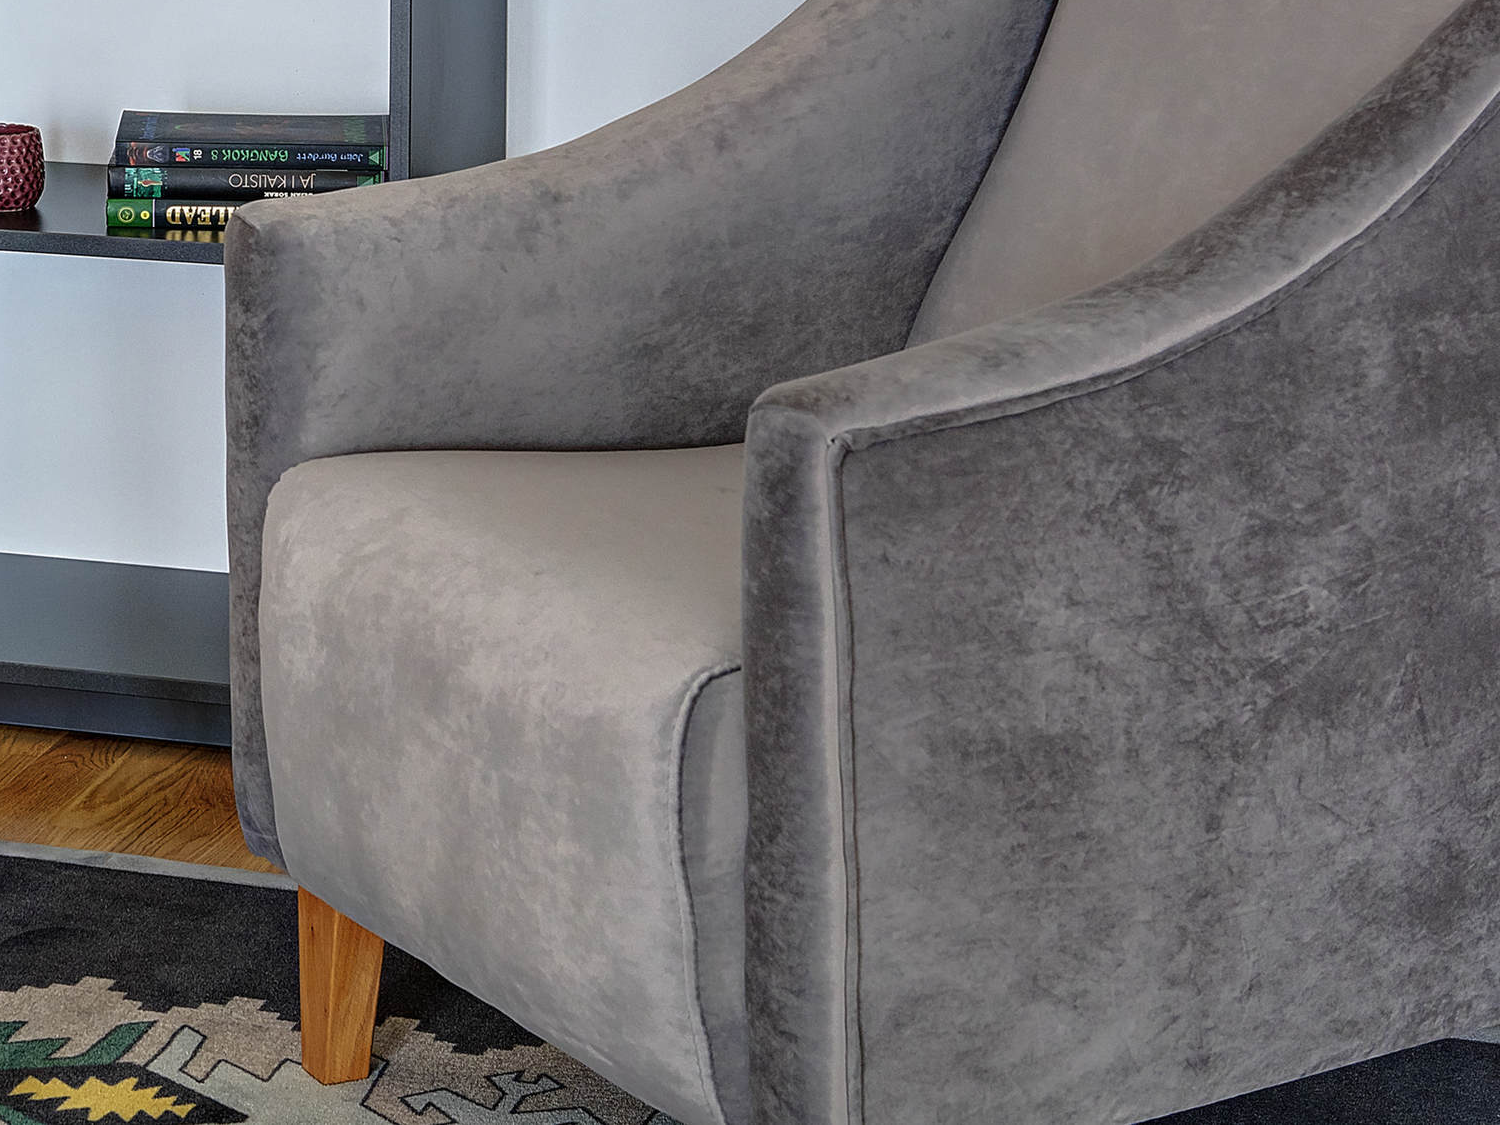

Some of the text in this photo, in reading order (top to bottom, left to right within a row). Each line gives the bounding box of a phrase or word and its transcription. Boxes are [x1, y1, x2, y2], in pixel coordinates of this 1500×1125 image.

[192, 149, 203, 160] 18
[210, 148, 289, 162] BANGKOK 8
[296, 152, 364, 163] John Burdett
[228, 172, 317, 188] JA I KALISTO
[166, 205, 240, 225] ILEAD
